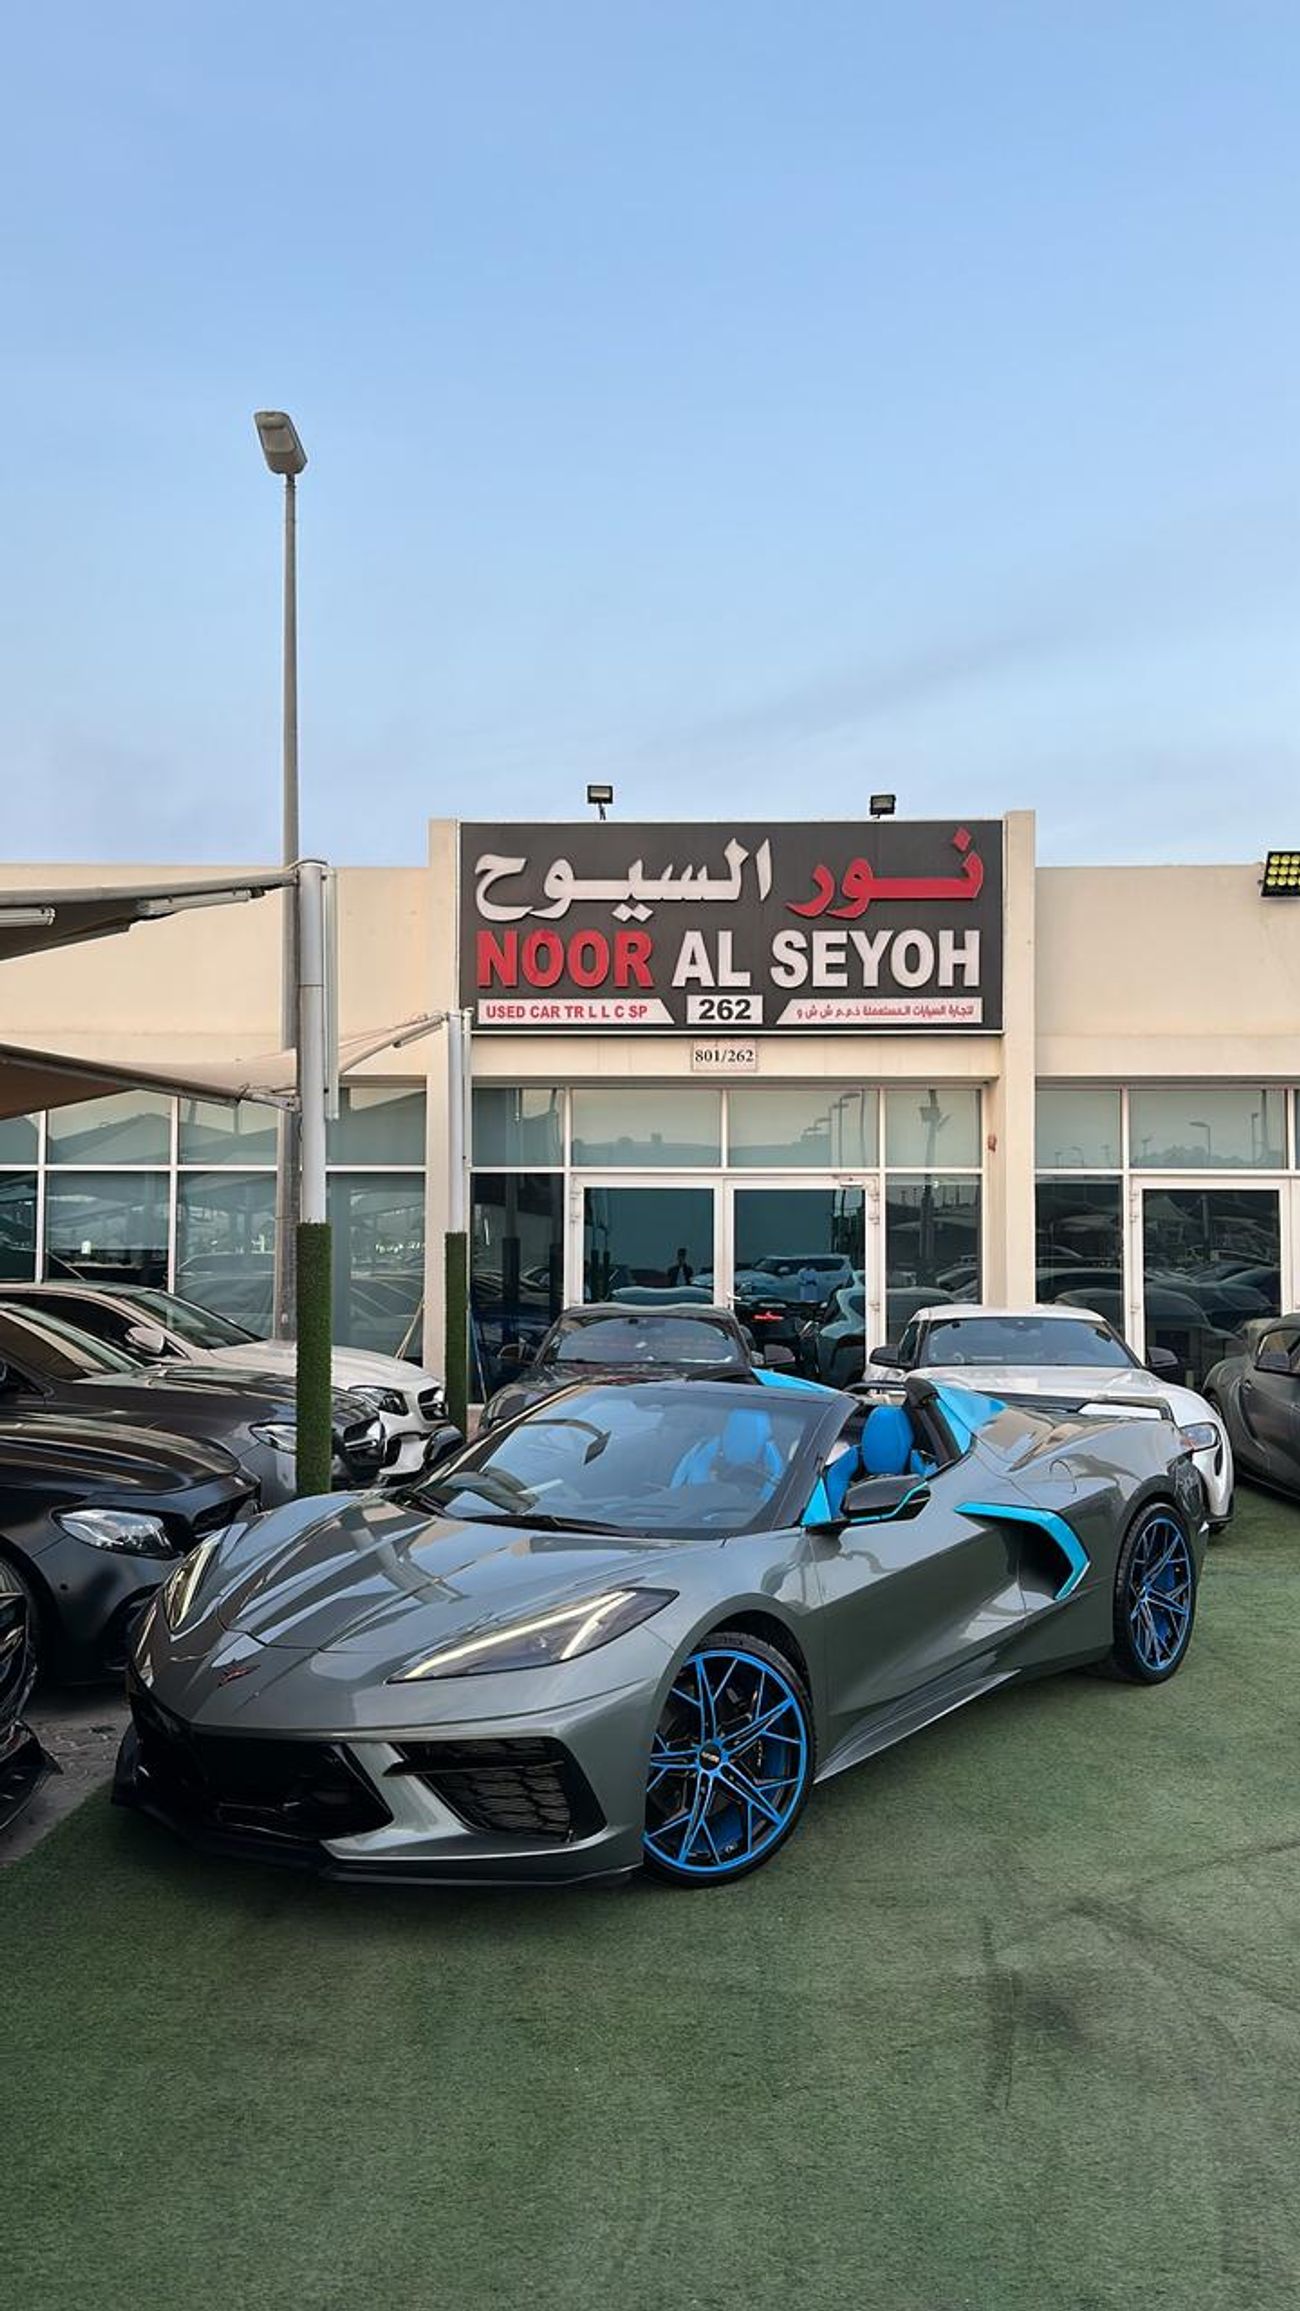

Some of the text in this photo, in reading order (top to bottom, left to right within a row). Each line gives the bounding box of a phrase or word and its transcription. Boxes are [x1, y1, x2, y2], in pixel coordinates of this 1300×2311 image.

[475, 827, 984, 922] نور السيوح
[476, 929, 980, 988] NOOR AL SEYOH
[486, 1005, 648, 1018] USED CAR TR L L C SP
[699, 998, 751, 1020] 262
[695, 1049, 754, 1062] 801/262
